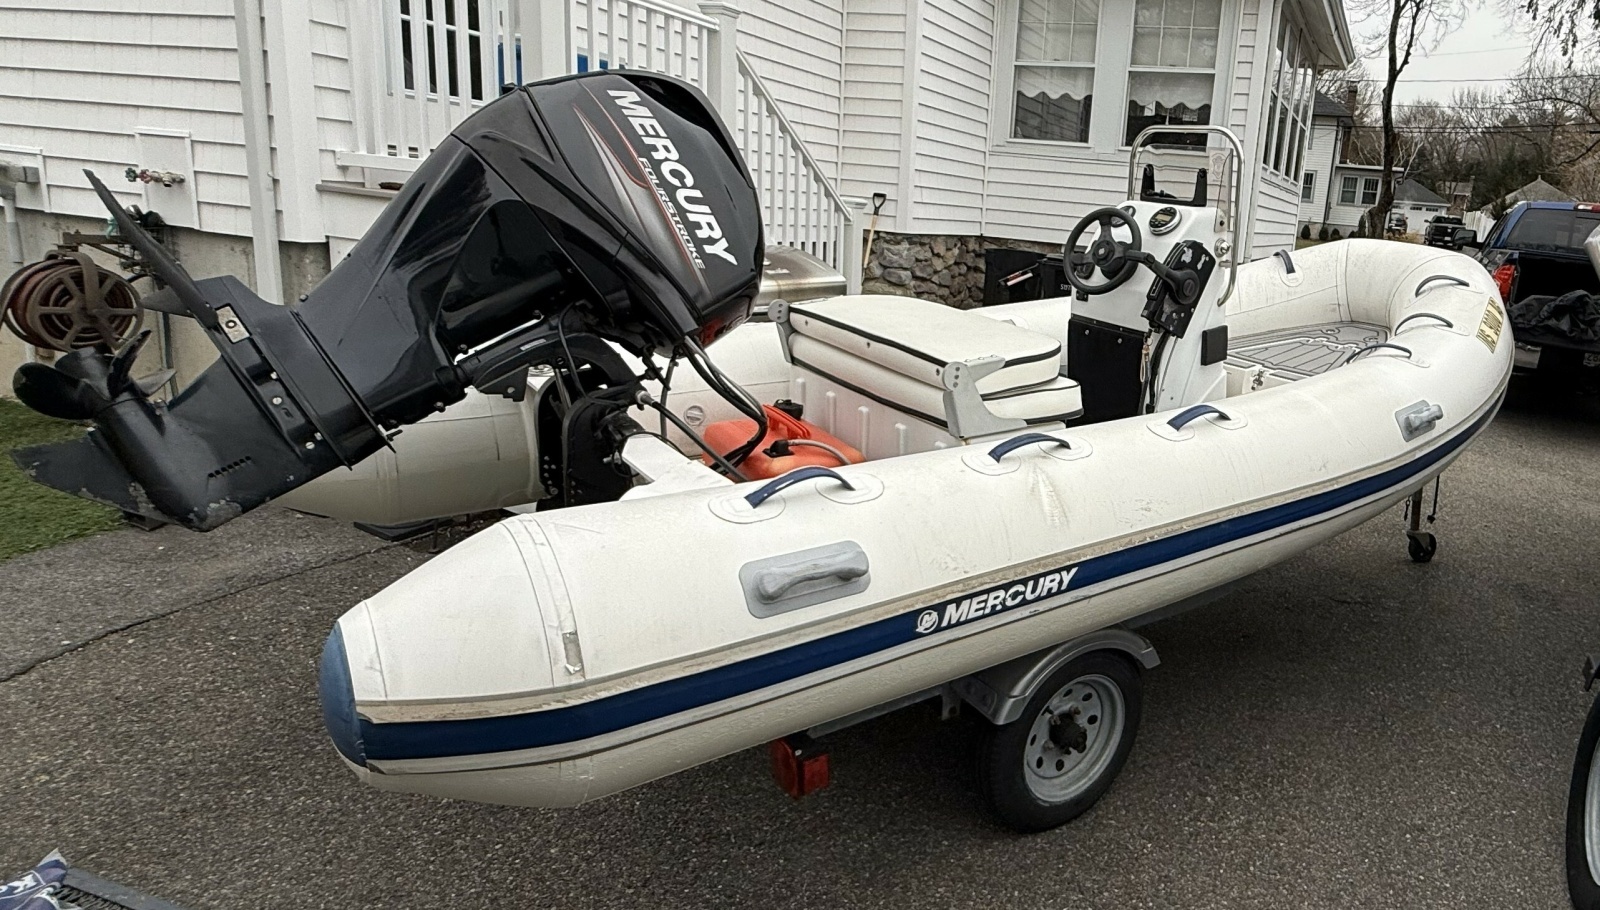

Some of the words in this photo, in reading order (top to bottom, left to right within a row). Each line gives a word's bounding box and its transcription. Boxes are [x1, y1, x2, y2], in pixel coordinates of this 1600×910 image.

[606, 89, 738, 266] MERCURY
[639, 157, 705, 270] FOURSTROKE
[941, 567, 1079, 628] MERCURY
